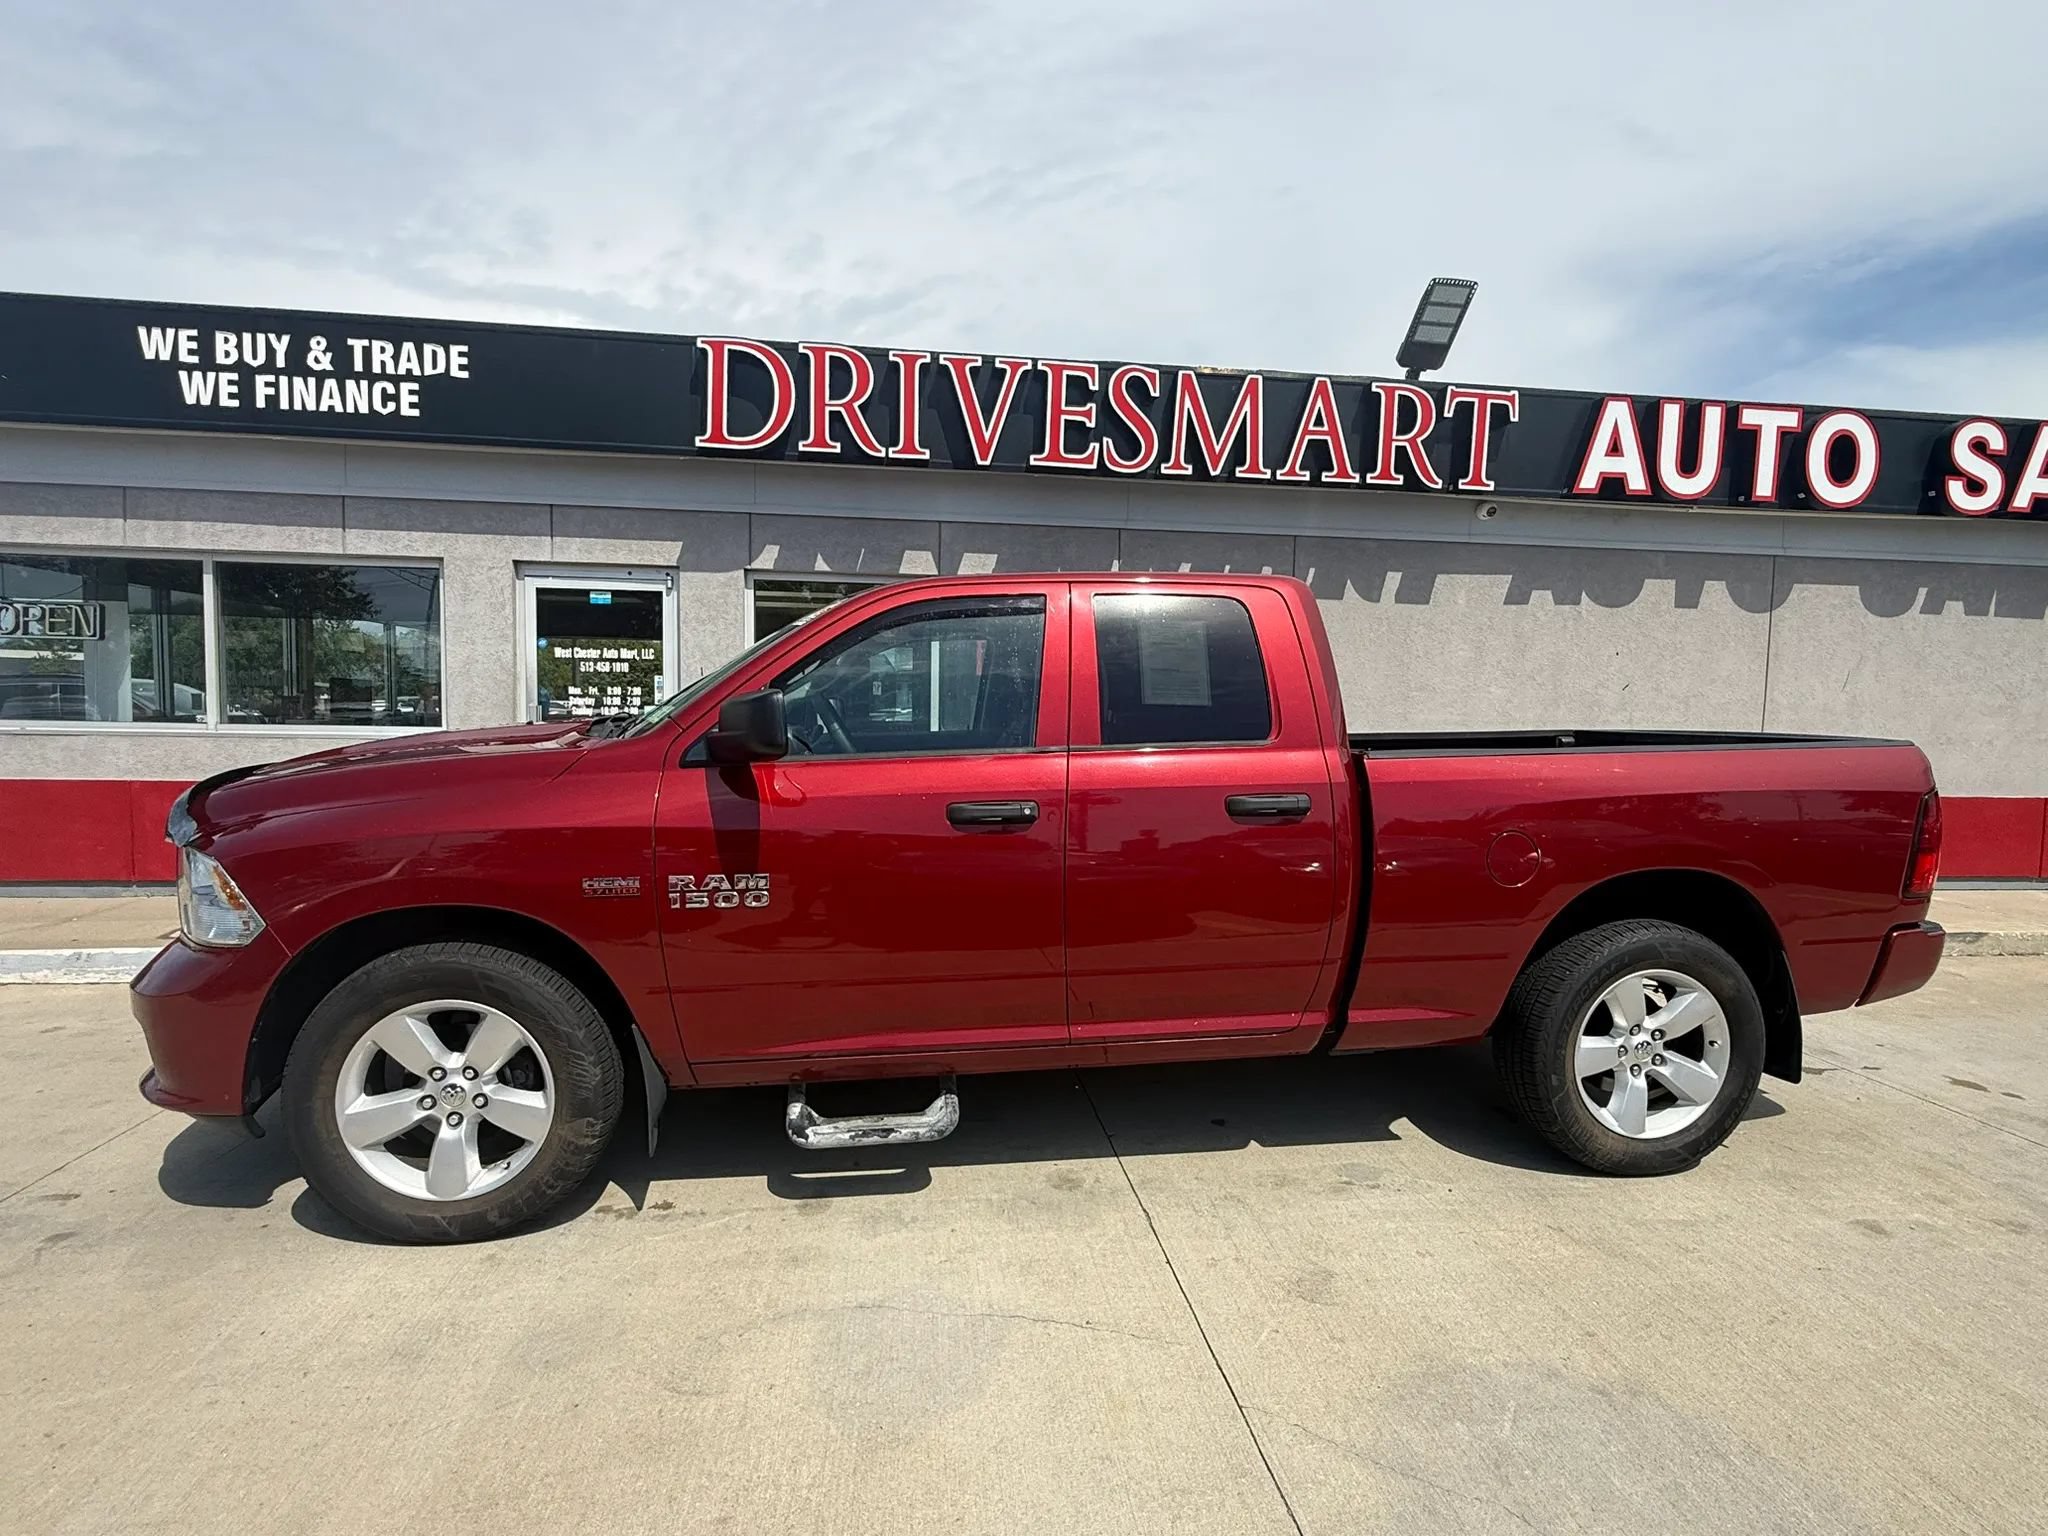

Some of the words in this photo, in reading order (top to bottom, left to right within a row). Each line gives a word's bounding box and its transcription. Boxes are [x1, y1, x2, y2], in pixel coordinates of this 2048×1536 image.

[137, 326, 200, 363] WE
[215, 330, 291, 368] BUY
[306, 335, 335, 371] &
[347, 337, 470, 379] TRADE
[178, 370, 240, 407] WE
[255, 374, 420, 417] FINANCE
[694, 337, 1521, 492] DRIVESMART
[1572, 395, 1881, 509] AUTO
[0, 603, 95, 636] OPEN
[554, 647, 572, 658] West
[573, 647, 601, 659] Chester
[602, 648, 619, 659] Auto
[641, 648, 655, 660] LLC
[668, 873, 769, 890] RAM
[668, 891, 769, 908] 1500
